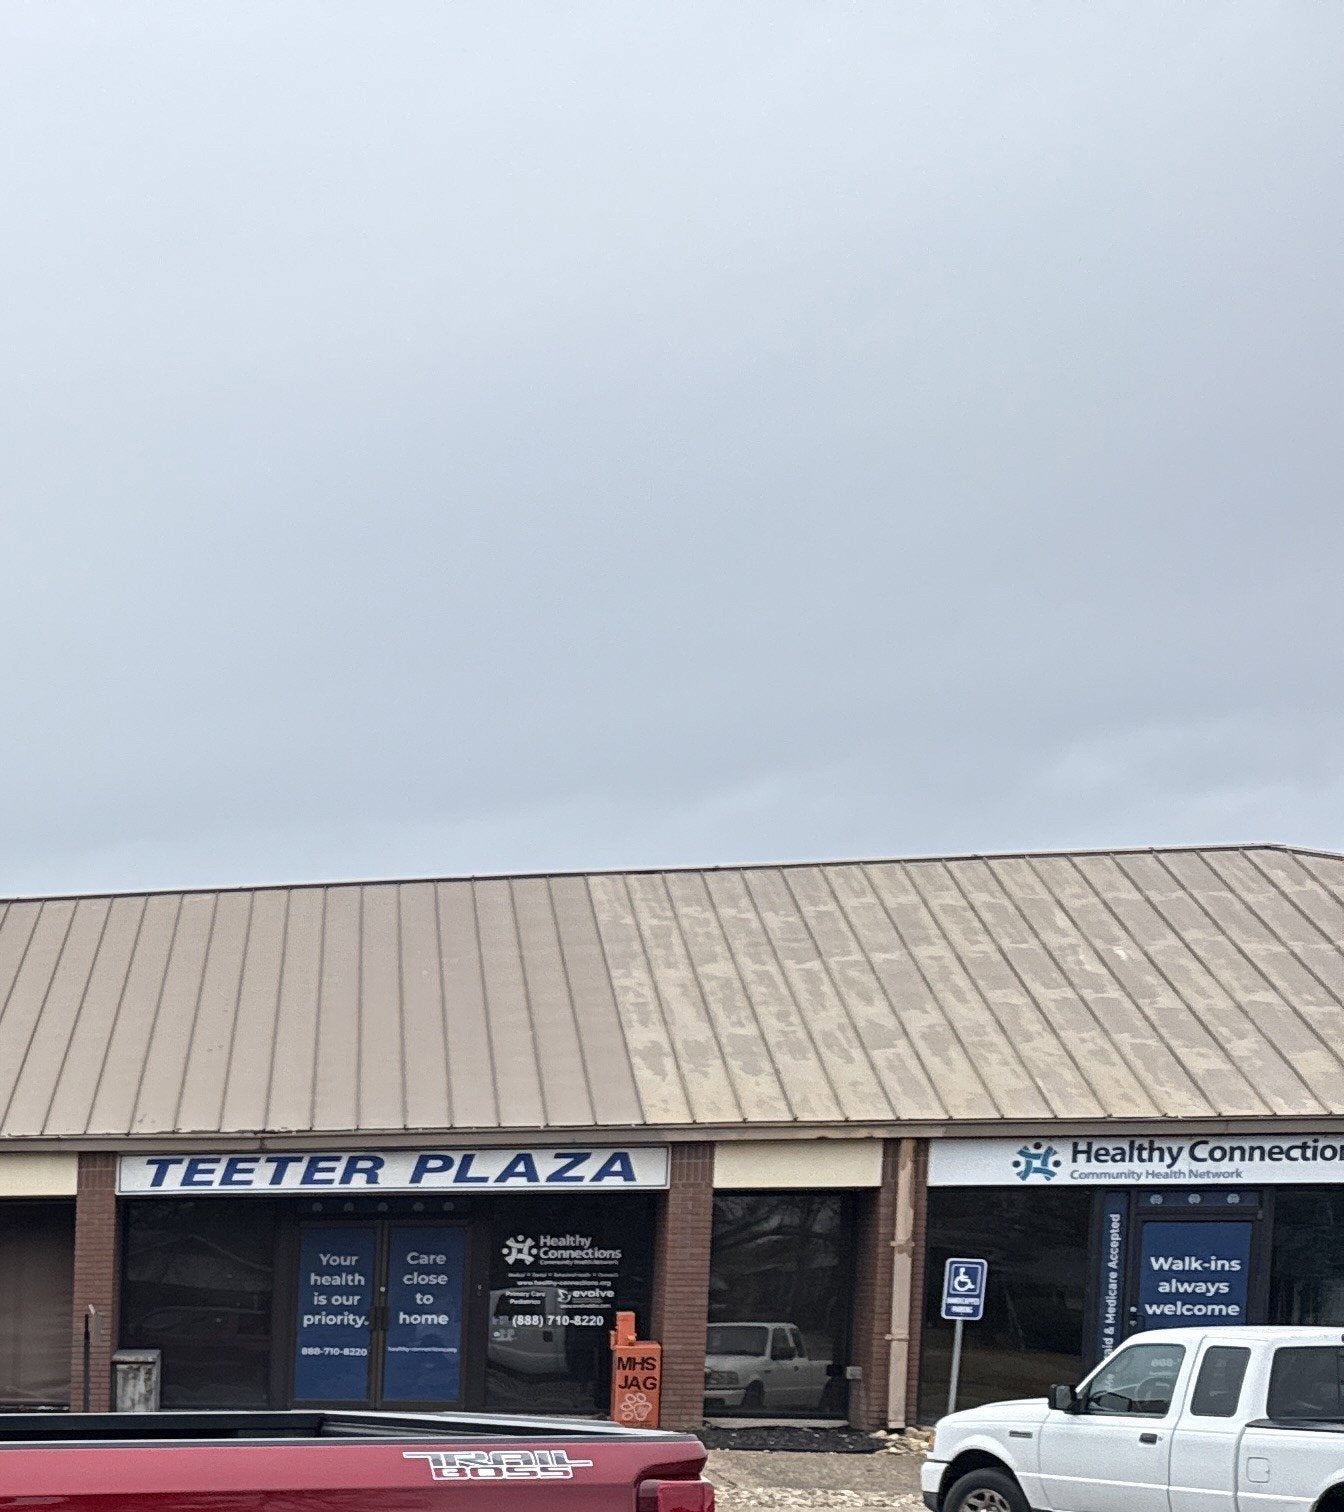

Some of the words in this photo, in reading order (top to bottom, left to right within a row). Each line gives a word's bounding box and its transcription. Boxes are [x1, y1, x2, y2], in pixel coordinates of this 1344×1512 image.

[1070, 1140, 1185, 1168] Healthy
[1189, 1138, 1344, 1163] Connectio
[145, 1154, 385, 1188] TEETER
[409, 1152, 638, 1184] PLAZA
[1070, 1169, 1143, 1181] Community
[1145, 1168, 1186, 1180] Health
[1188, 1168, 1244, 1180] Network
[539, 1234, 592, 1249] Healthy
[1108, 1213, 1121, 1269] Accepted
[319, 1253, 359, 1266] Your
[406, 1252, 448, 1265] Care
[539, 1246, 622, 1259] Connections
[1150, 1256, 1242, 1271] Walk-ins
[310, 1272, 365, 1286] health
[402, 1272, 449, 1285] close
[572, 1288, 615, 1298] evolve
[1157, 1279, 1230, 1296] always
[313, 1292, 327, 1305] is
[331, 1294, 361, 1305] our
[415, 1292, 434, 1305] to
[1104, 1271, 1118, 1324] Medicare
[1144, 1301, 1240, 1316] welcome
[303, 1311, 370, 1328] priority.
[399, 1311, 450, 1325] home
[512, 1315, 544, 1327] (888)
[546, 1315, 604, 1326] 710-8220
[1106, 1326, 1115, 1336] &
[617, 1356, 657, 1371] MHS
[618, 1375, 658, 1390] JAG
[402, 1450, 594, 1467] TRAIL
[432, 1465, 573, 1480] BOSS
